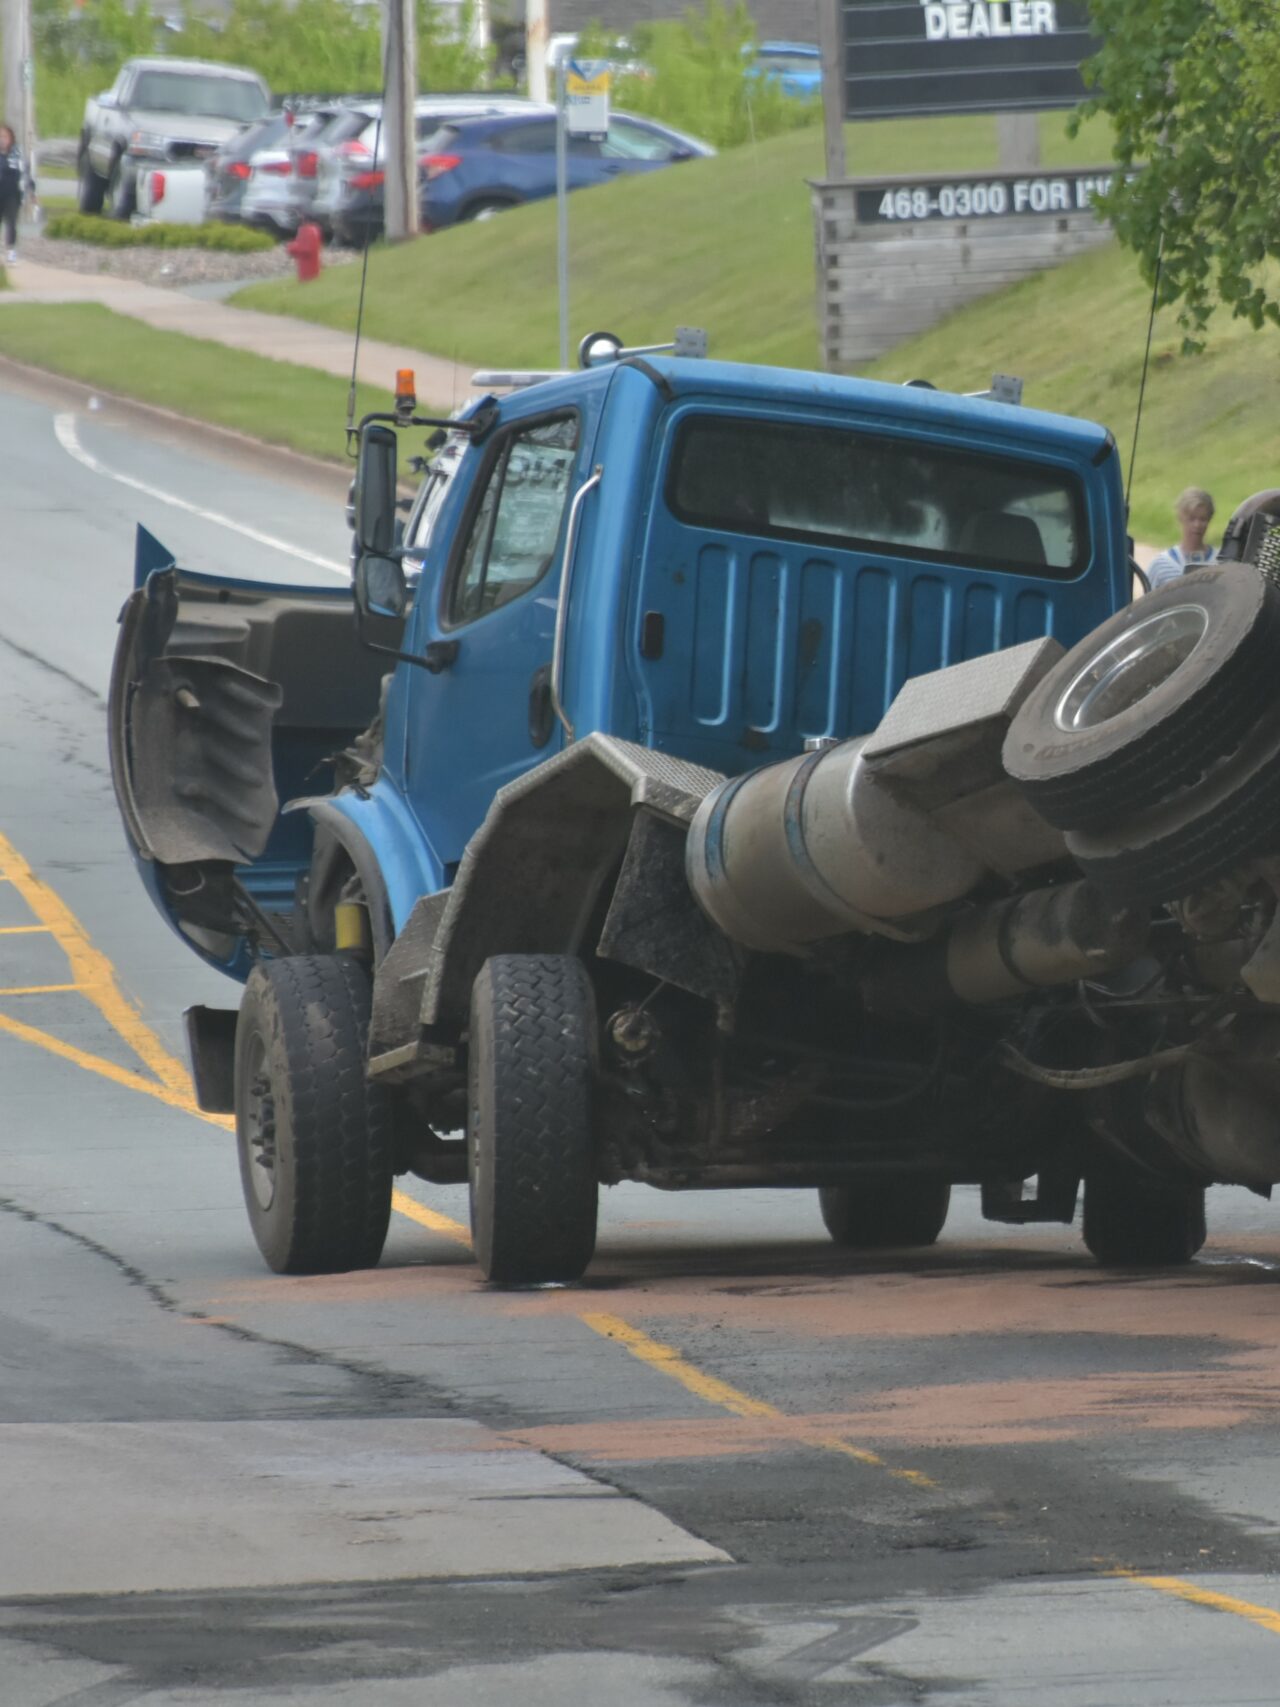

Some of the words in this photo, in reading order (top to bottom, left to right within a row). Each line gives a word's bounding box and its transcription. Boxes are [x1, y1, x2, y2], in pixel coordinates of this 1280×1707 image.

[924, 0, 1057, 40] DEALER
[878, 182, 1007, 219] 468-0300
[1012, 178, 1070, 213] FOR
